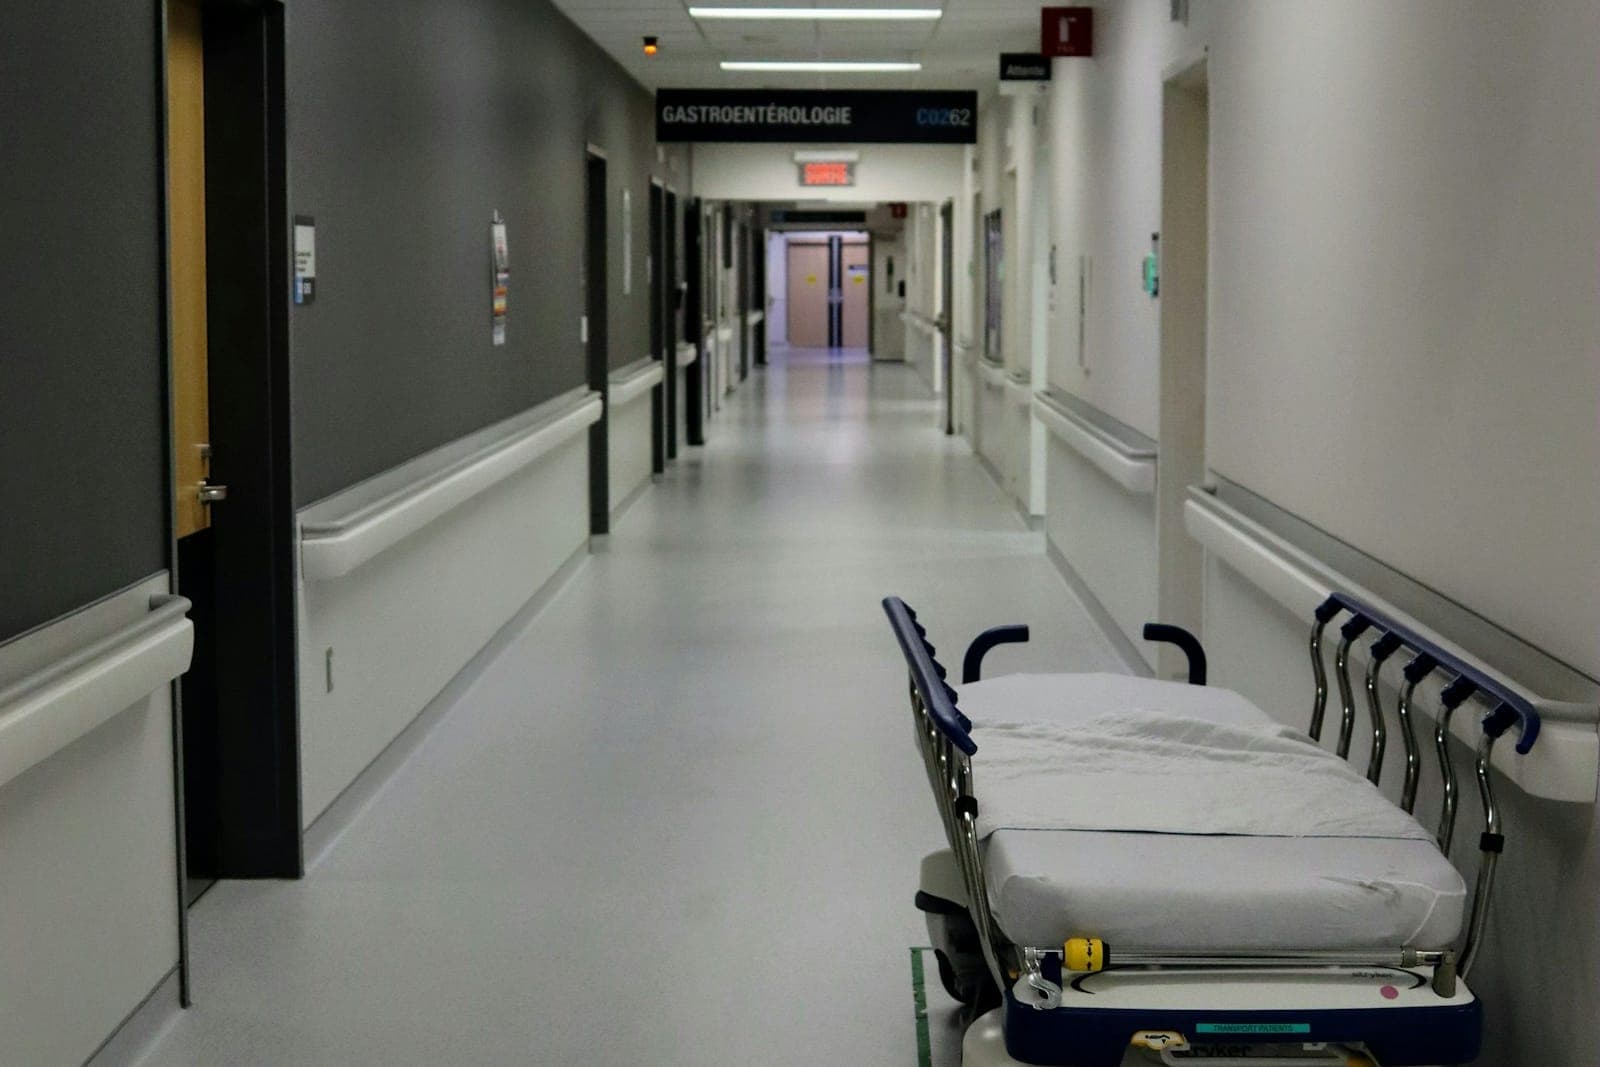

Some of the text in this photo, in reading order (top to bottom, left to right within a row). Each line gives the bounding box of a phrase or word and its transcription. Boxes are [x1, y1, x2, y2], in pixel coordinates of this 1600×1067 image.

[662, 102, 852, 125] GASTROENTÉROLOGIE
[1213, 1024, 1293, 1033] TRANSPORT PATIENTS
